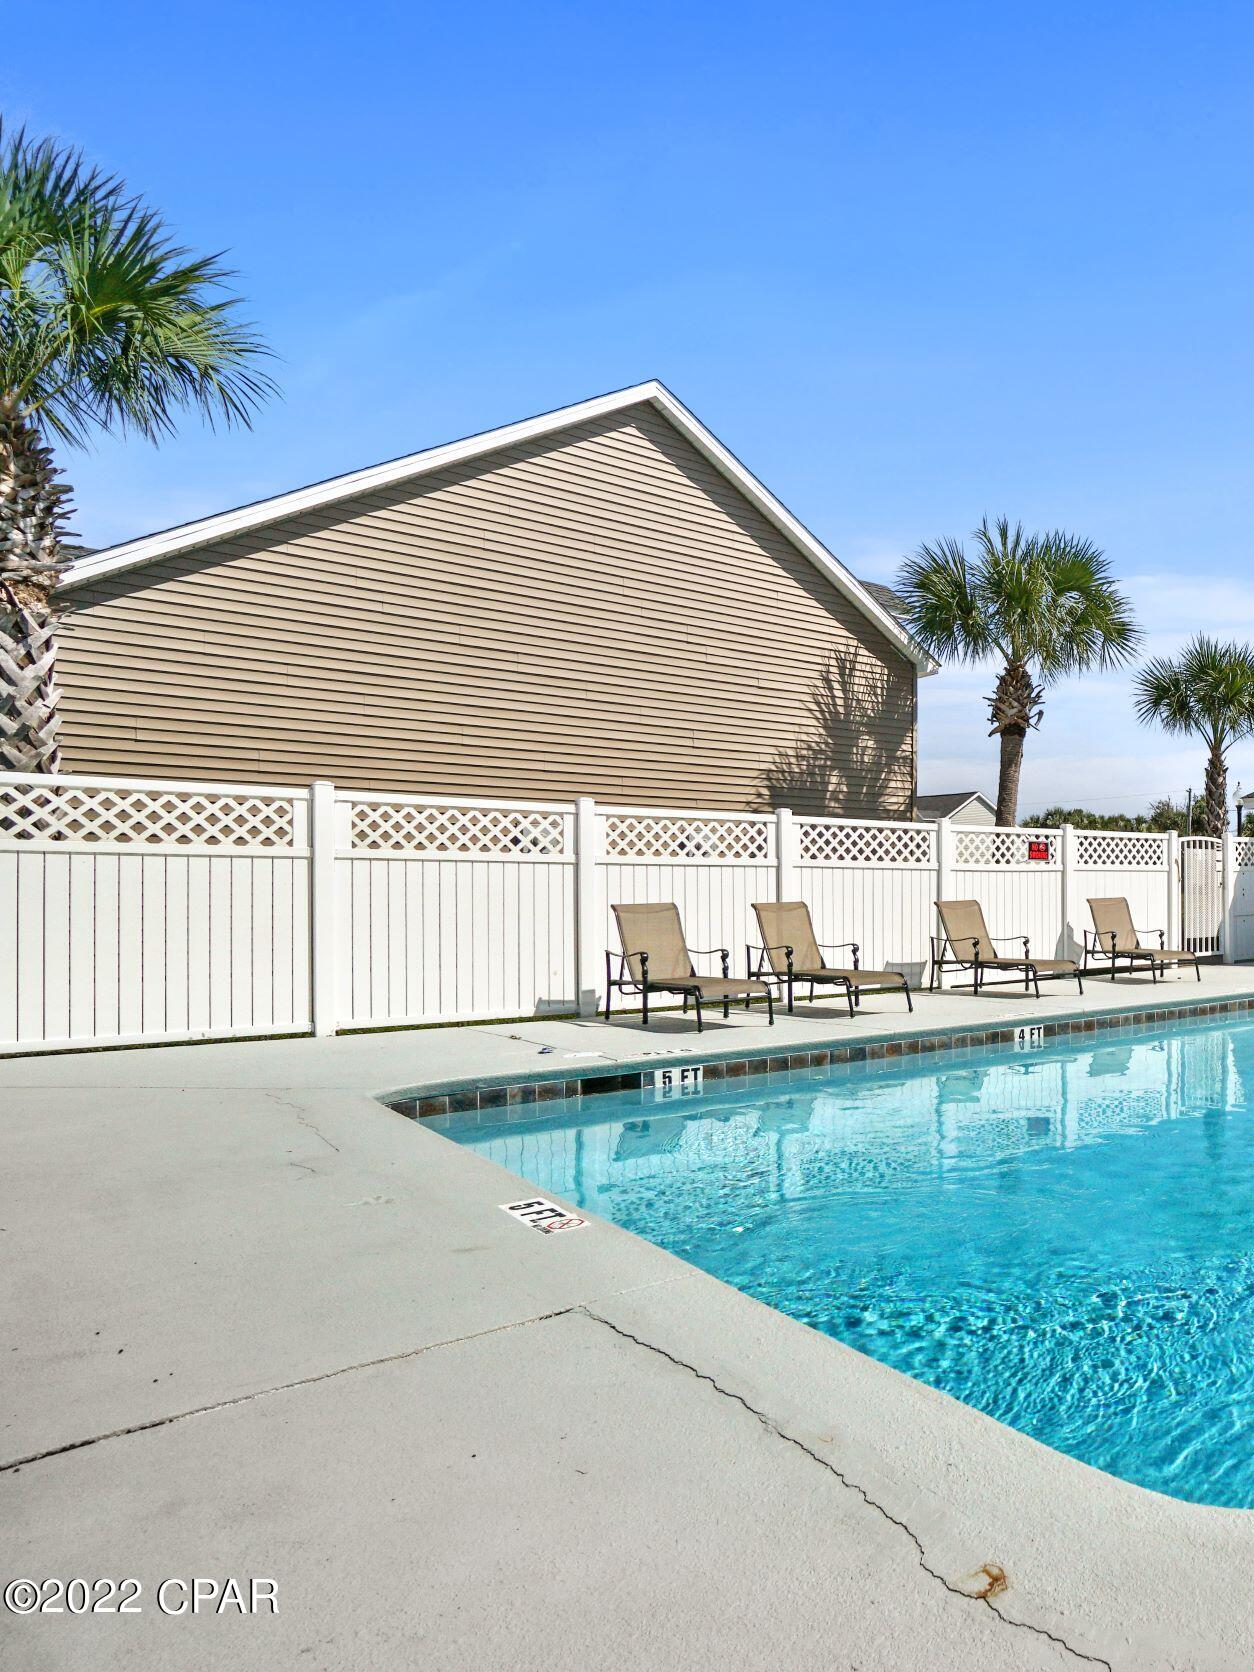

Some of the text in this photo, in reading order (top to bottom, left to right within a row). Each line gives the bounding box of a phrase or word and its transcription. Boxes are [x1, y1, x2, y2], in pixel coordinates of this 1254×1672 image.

[1032, 842, 1039, 851] NO
[1018, 1026, 1042, 1041] 4 FT
[662, 1067, 701, 1086] 5 FT
[508, 1200, 545, 1211] 5
